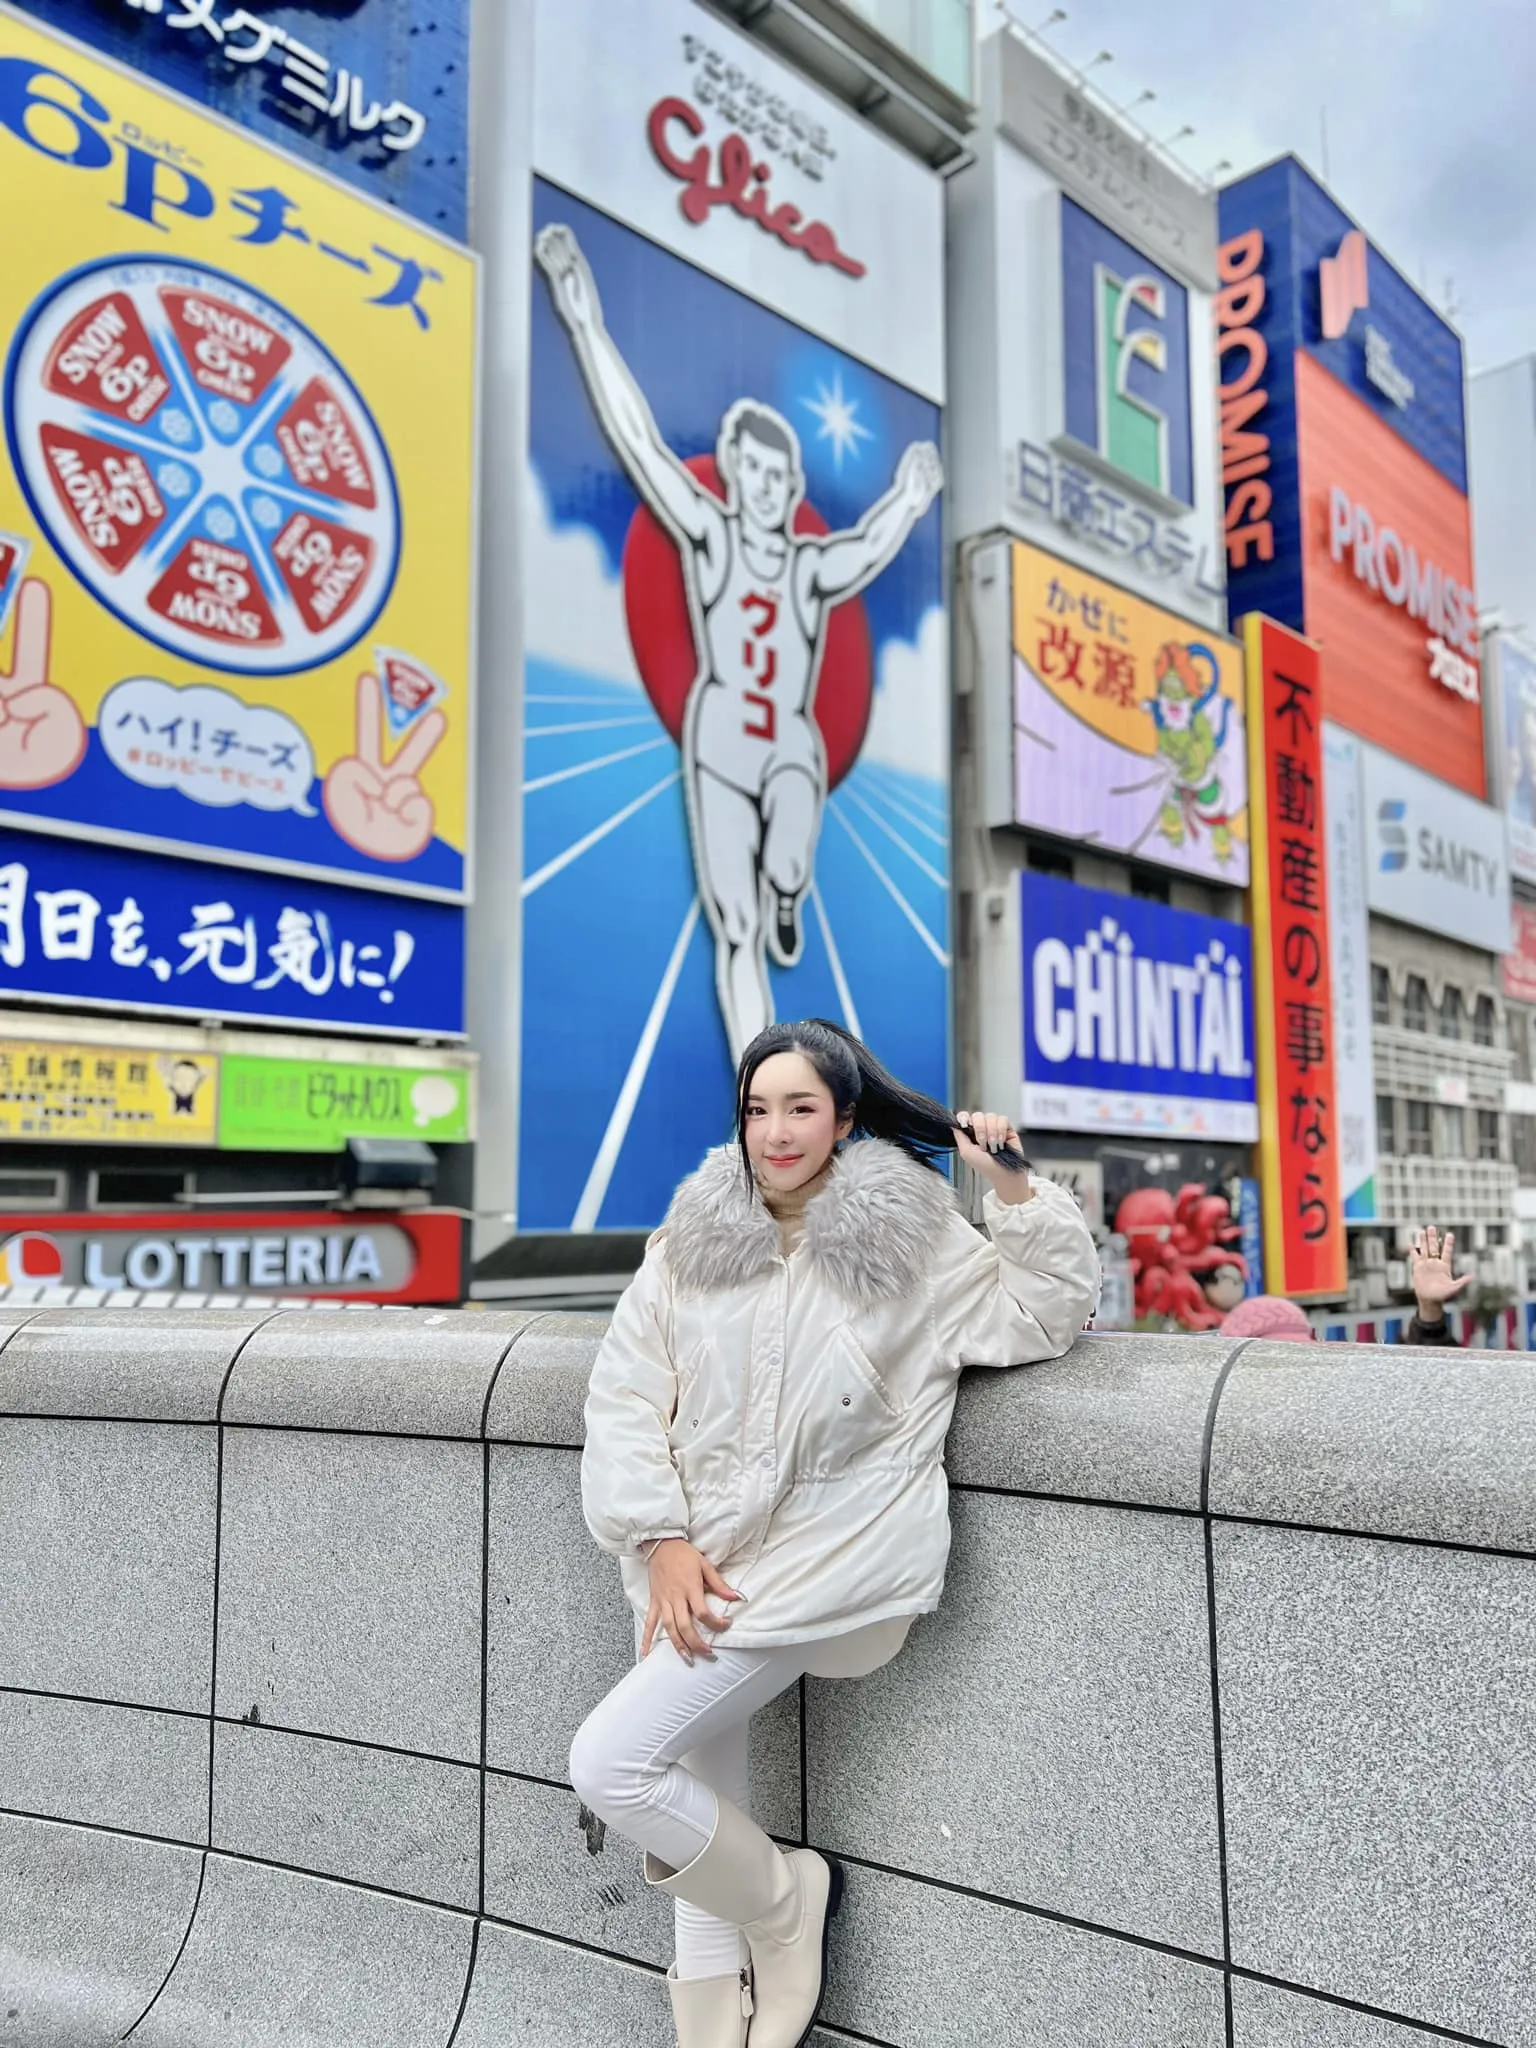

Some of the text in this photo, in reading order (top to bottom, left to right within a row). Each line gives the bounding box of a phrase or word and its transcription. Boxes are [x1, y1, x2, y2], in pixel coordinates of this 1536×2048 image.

[122, 0, 427, 150] メグミルク
[646, 96, 867, 279] Glico
[58, 302, 128, 384] SNOW
[182, 298, 274, 354] SNOW
[315, 400, 371, 490] SNOW
[49, 446, 119, 547] SNOW
[168, 592, 262, 639] SNOW
[310, 545, 364, 622] SNOW
[1047, 577, 1129, 643] かぜに
[1329, 484, 1478, 658] PROMISE
[740, 589, 782, 742] グリコ
[1034, 617, 1137, 708] 改源
[1418, 827, 1498, 898] SAMTY
[1273, 672, 1330, 1241] 不動産の事なら
[84, 1235, 382, 1291] LOTTERIA
